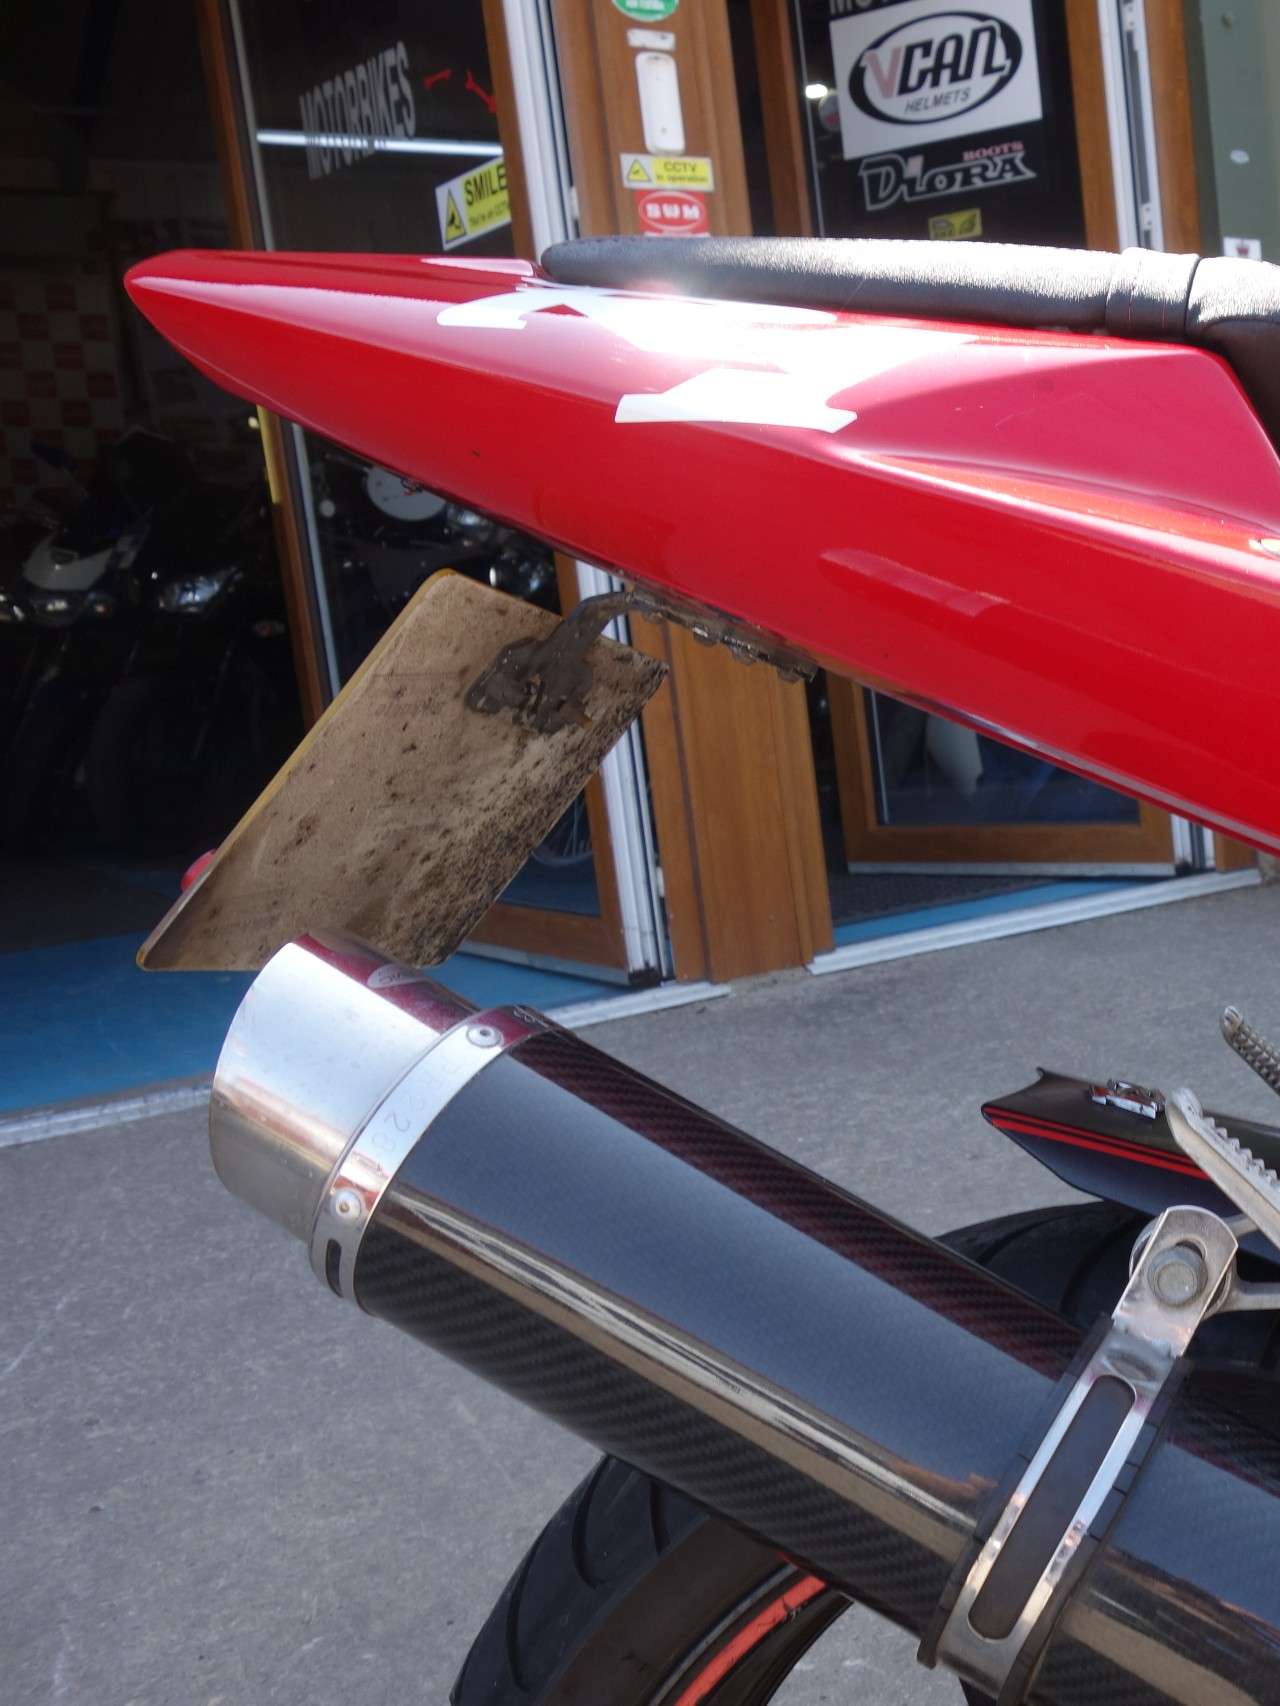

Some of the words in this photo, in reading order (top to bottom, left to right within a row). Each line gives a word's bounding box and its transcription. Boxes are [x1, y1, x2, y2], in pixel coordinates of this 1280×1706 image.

[864, 23, 1010, 99] VCAN
[298, 40, 417, 181] MOTORBIKES
[904, 87, 970, 115] HELMETS
[663, 161, 697, 173] CCTV
[963, 140, 1025, 161] BOOTS
[464, 163, 508, 208] SMILE
